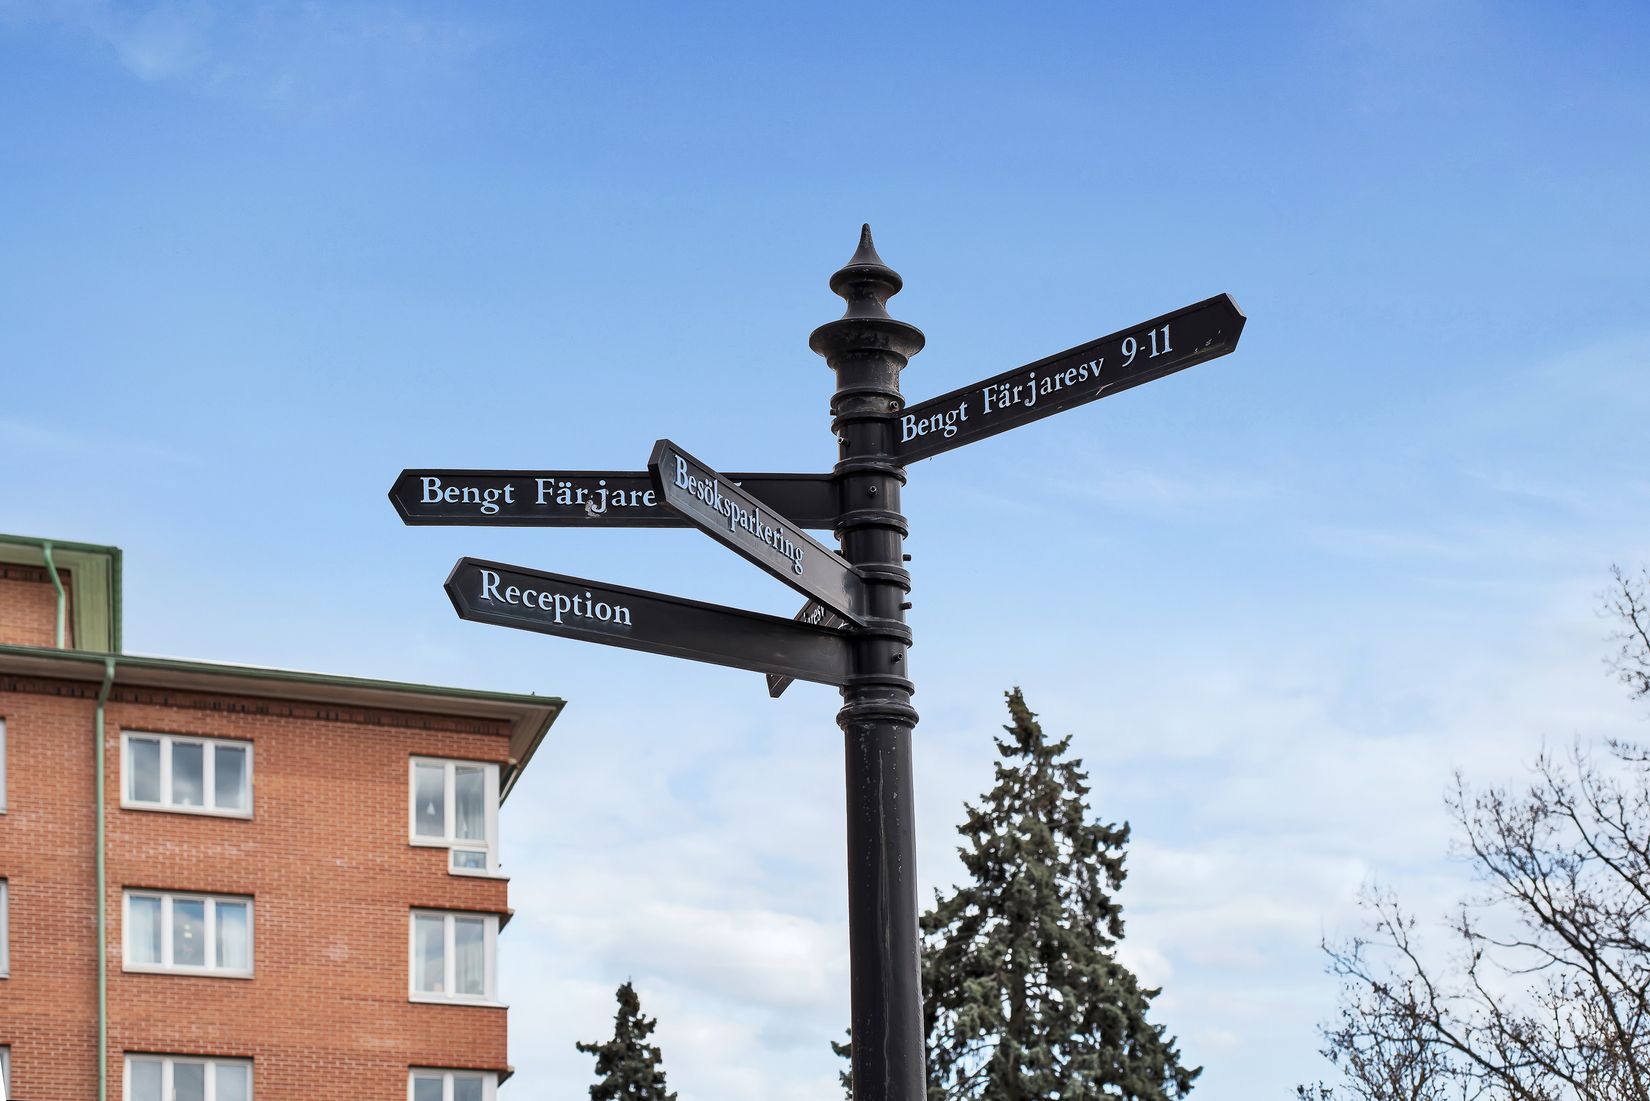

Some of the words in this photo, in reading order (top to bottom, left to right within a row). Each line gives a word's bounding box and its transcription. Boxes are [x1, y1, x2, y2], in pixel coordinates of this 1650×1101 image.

[900, 402, 969, 443] Bengt
[981, 357, 1104, 416] Färjaresv
[1121, 323, 1174, 368] 9-11
[419, 476, 516, 516] Bengt
[535, 478, 658, 514] Färjare
[674, 454, 805, 576] Besöksparkering
[480, 569, 633, 626] Reception
